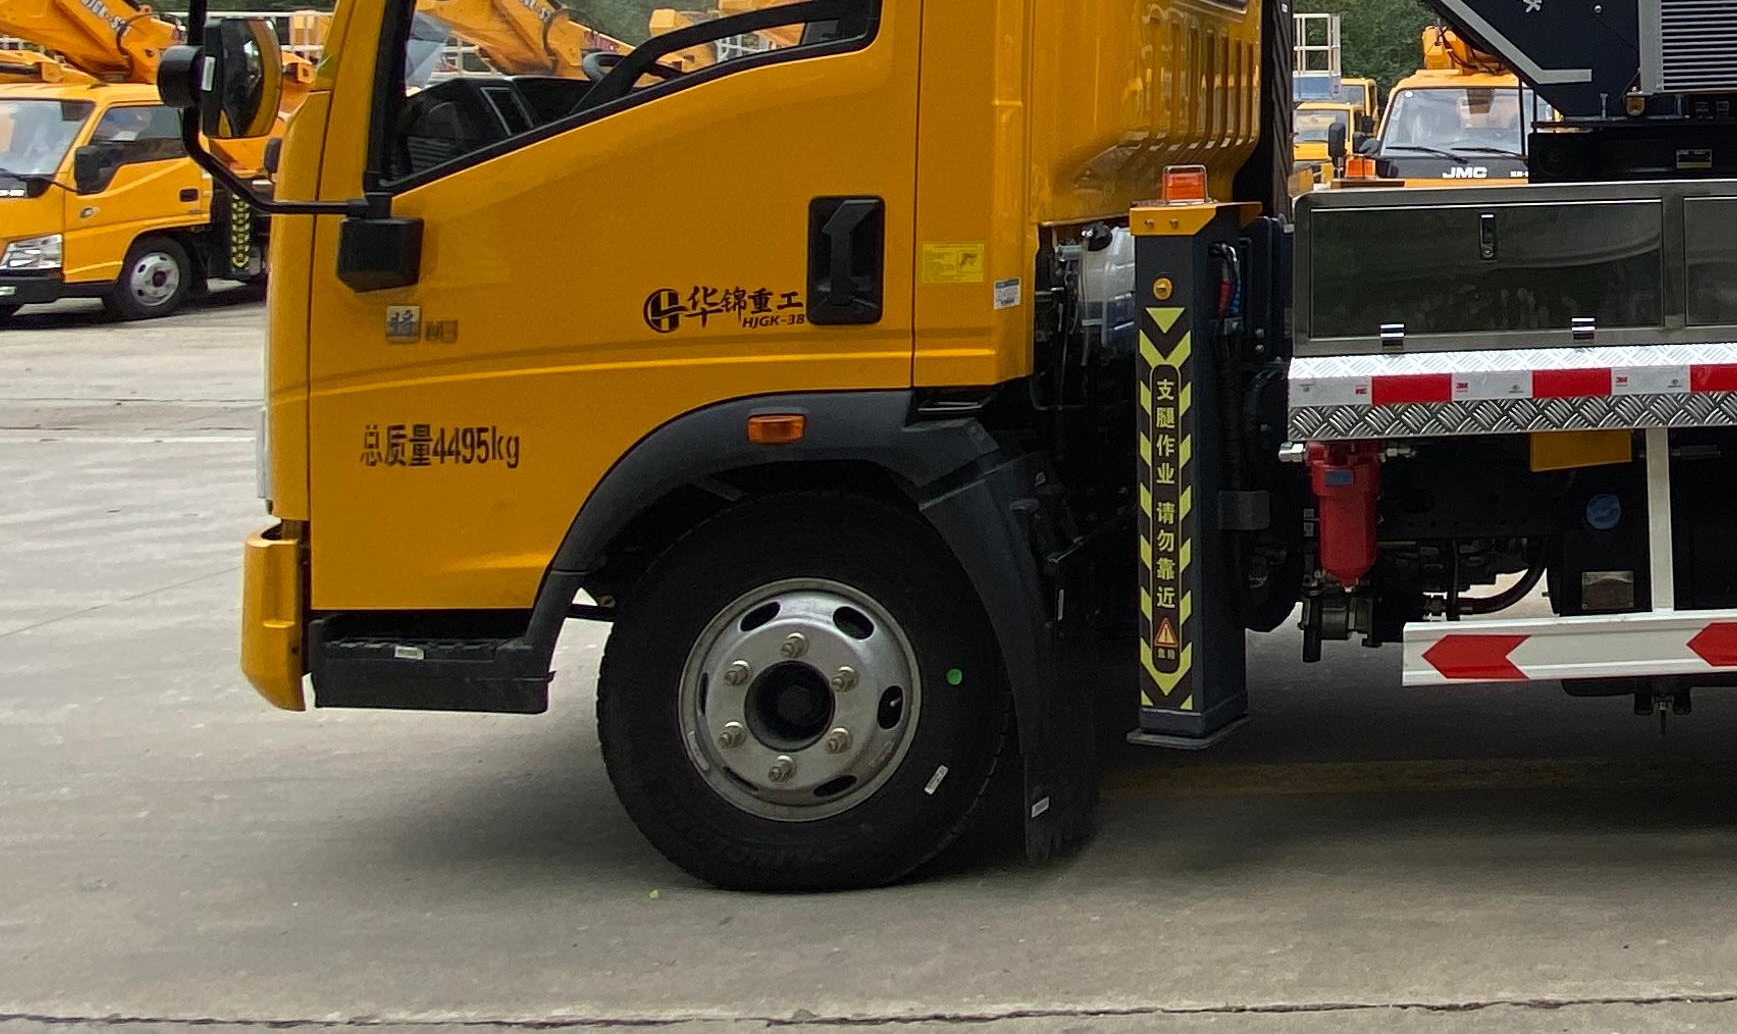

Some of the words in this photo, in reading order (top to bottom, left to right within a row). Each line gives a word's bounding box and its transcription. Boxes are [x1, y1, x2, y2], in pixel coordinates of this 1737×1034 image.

[1442, 166, 1488, 179] JMC
[685, 286, 803, 328] 华锦重工
[742, 314, 805, 330] HJGK-38
[359, 423, 520, 469] 总质量4495kg
[1155, 378, 1175, 485] 支腿作业
[1155, 501, 1176, 609] 请勿靠近
